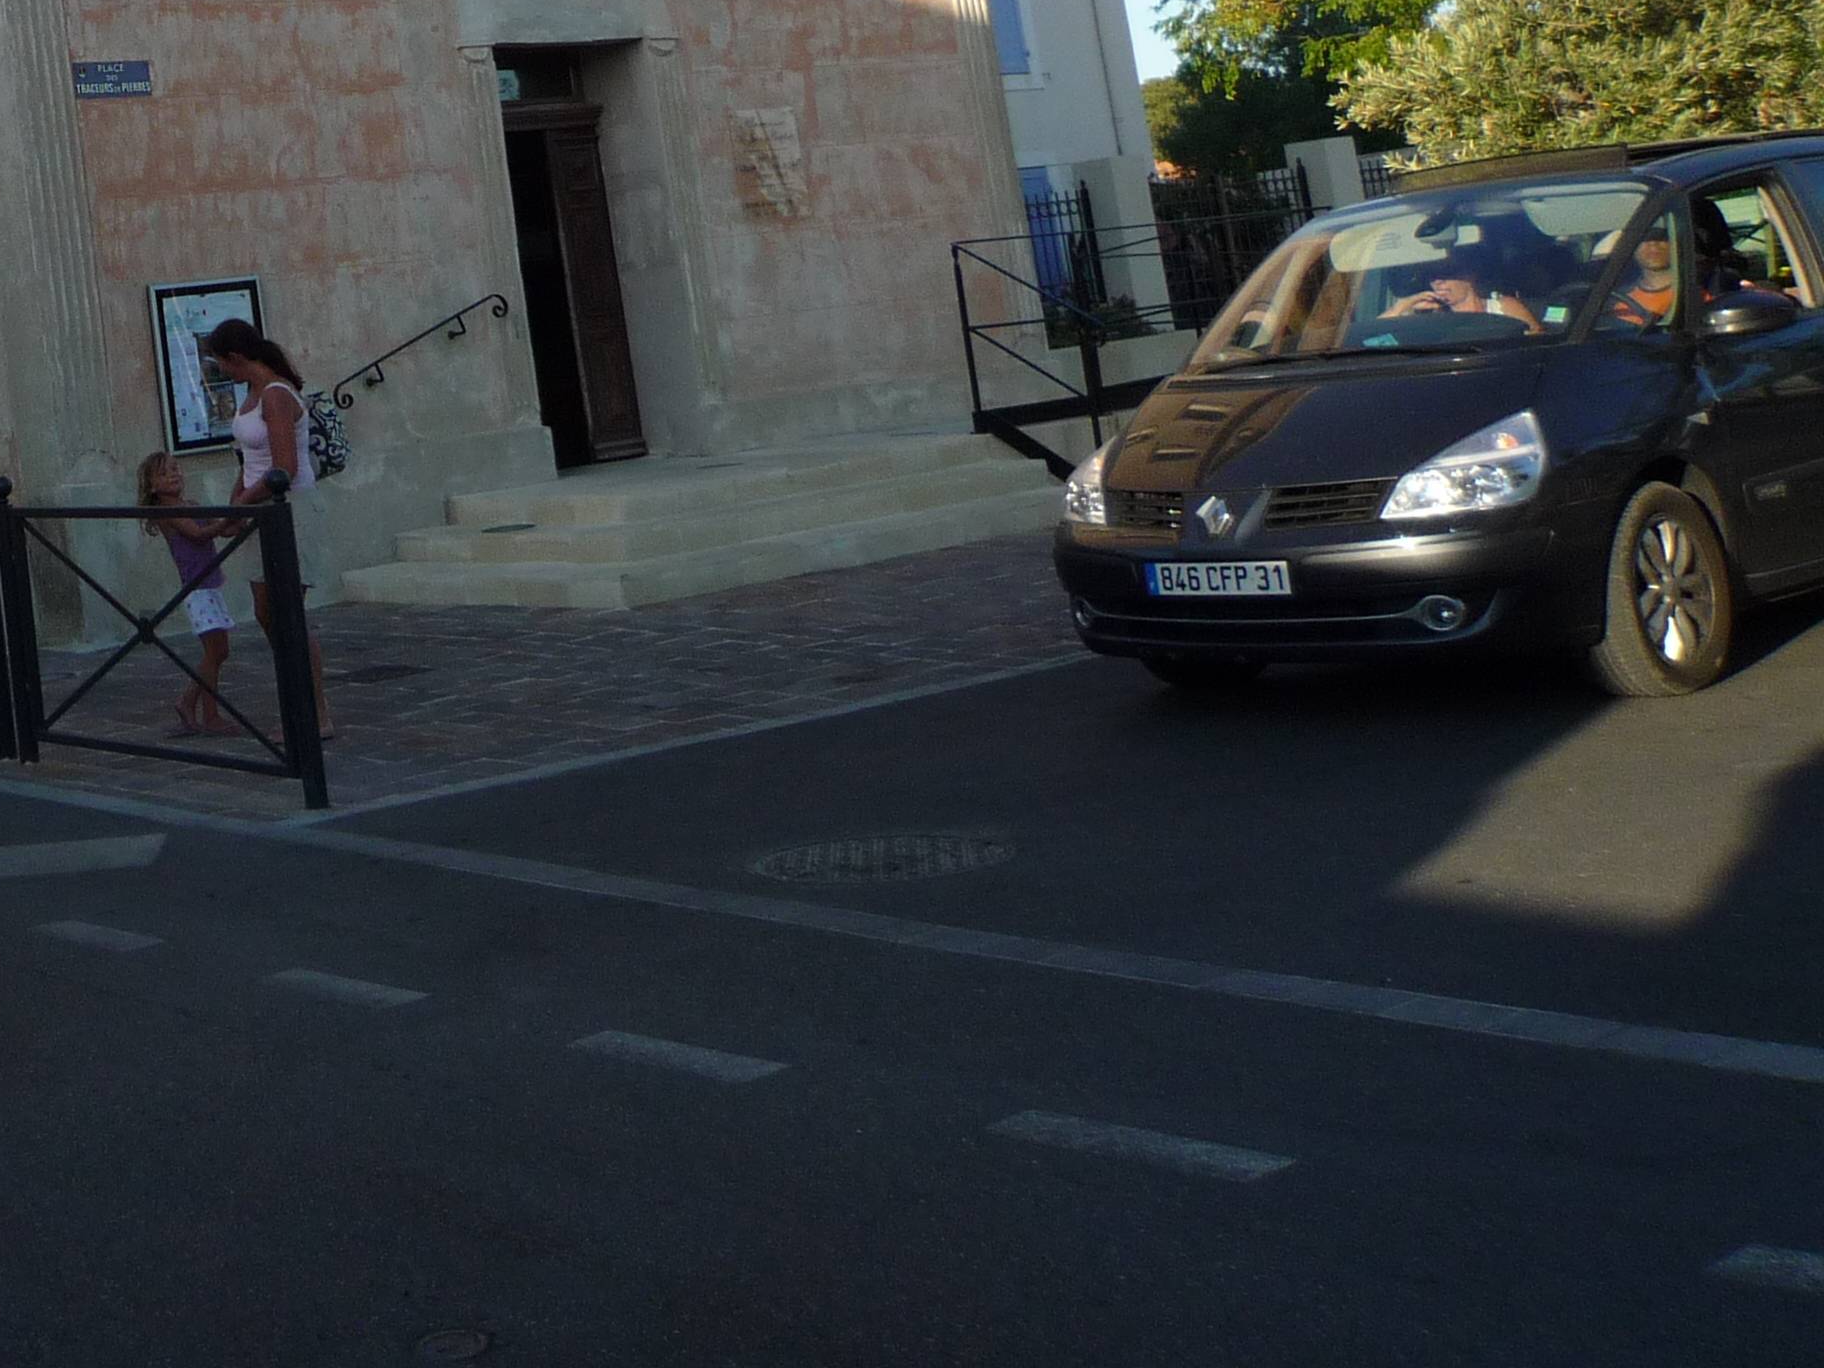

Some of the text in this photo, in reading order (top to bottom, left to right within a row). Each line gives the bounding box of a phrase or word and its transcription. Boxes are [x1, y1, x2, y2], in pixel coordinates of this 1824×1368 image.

[97, 63, 125, 72] PLACE
[121, 81, 151, 92] PIERRES
[1160, 565, 1284, 592] 846 CFP 31
